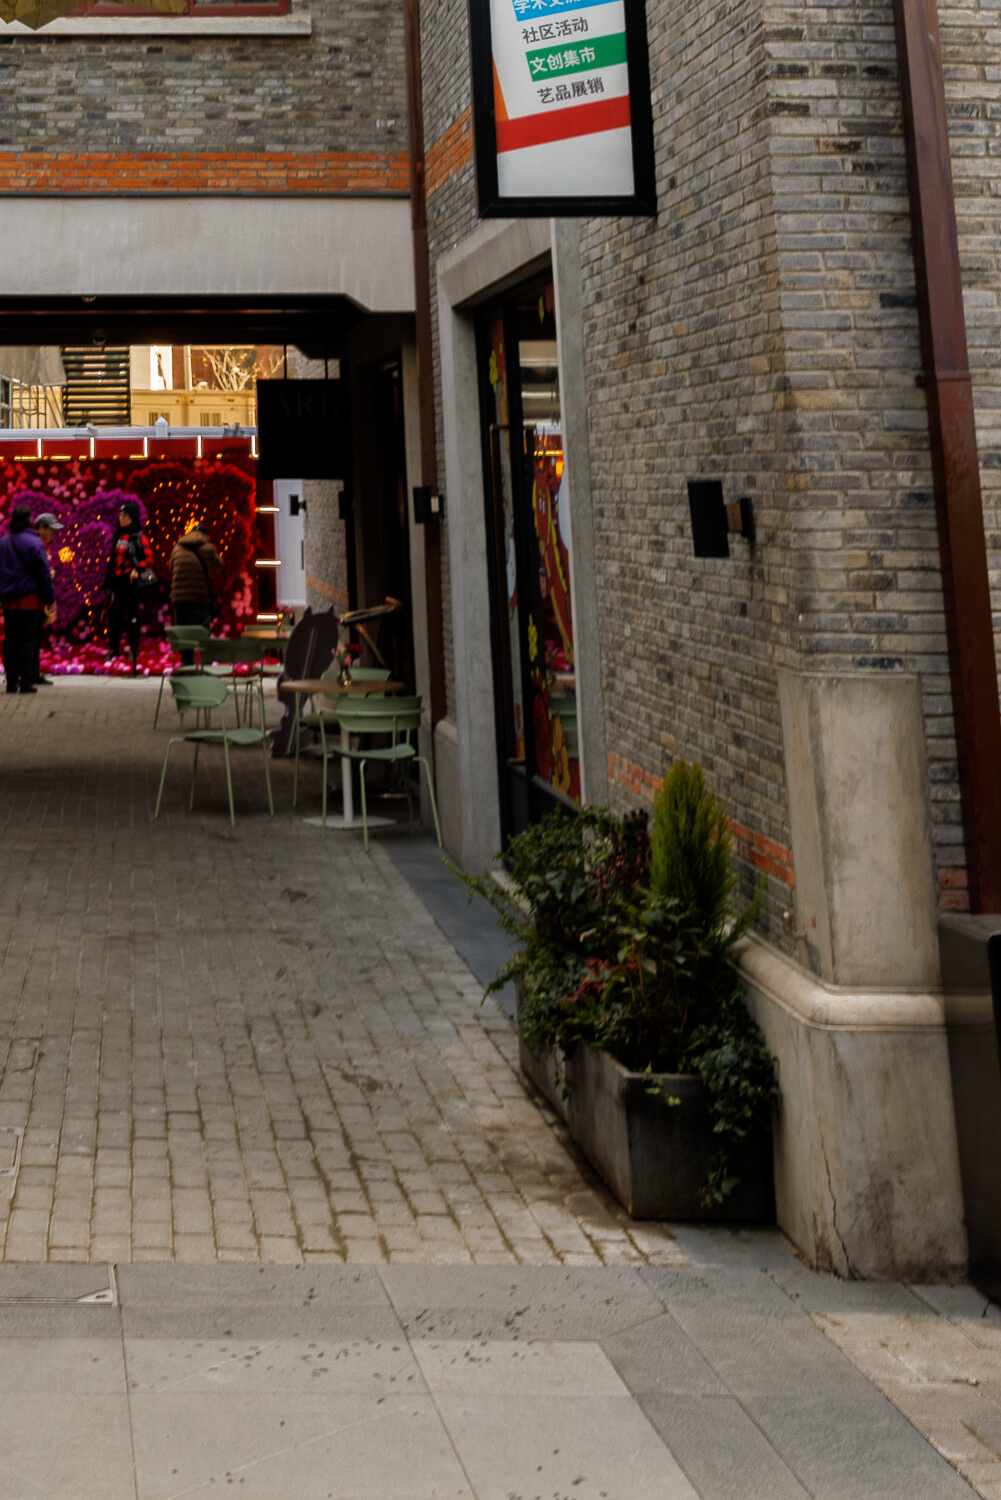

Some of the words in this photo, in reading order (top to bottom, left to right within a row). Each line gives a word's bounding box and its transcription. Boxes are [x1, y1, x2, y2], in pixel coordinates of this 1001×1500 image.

[522, 16, 589, 44] 社区活动
[529, 46, 596, 75] 文创集市
[537, 76, 604, 104] 艺品展销
